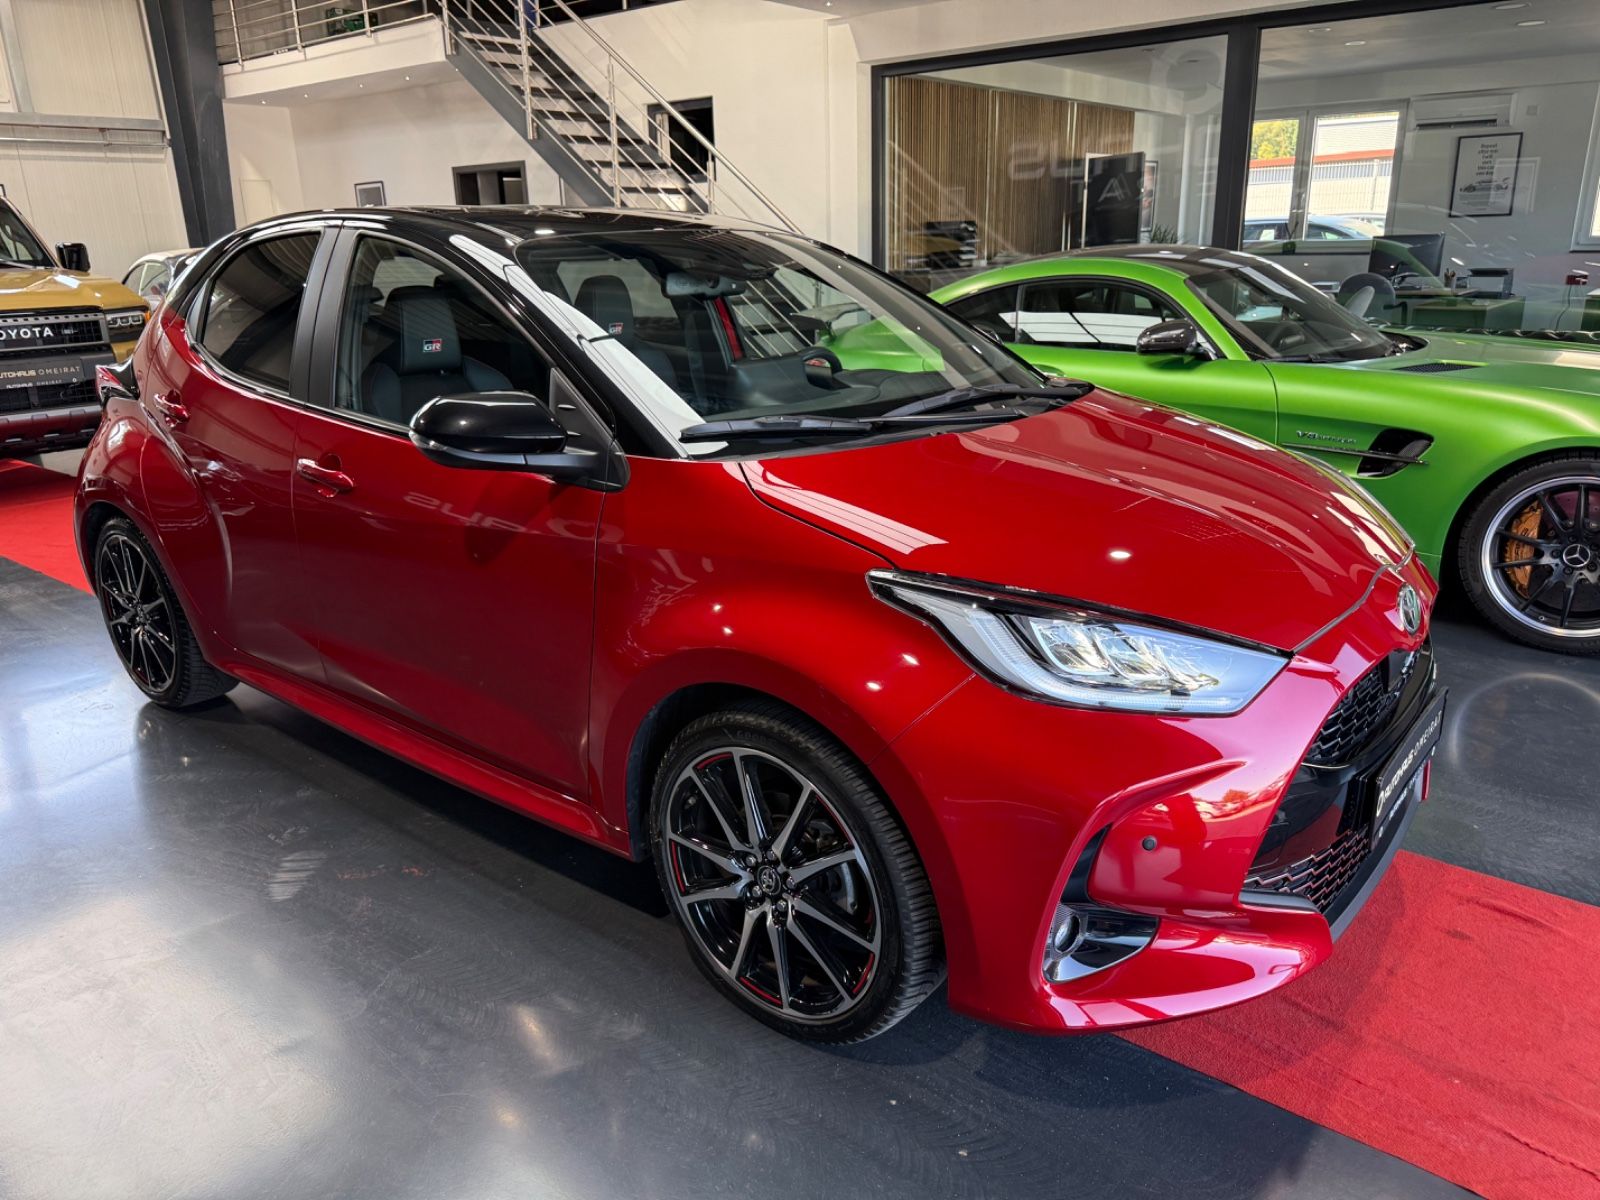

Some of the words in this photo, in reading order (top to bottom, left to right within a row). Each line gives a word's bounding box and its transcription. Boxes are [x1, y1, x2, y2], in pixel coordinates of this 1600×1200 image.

[0, 327, 54, 340] OYOTA
[0, 369, 37, 379] UTOHAUS
[38, 366, 80, 375] OMEIRAT
